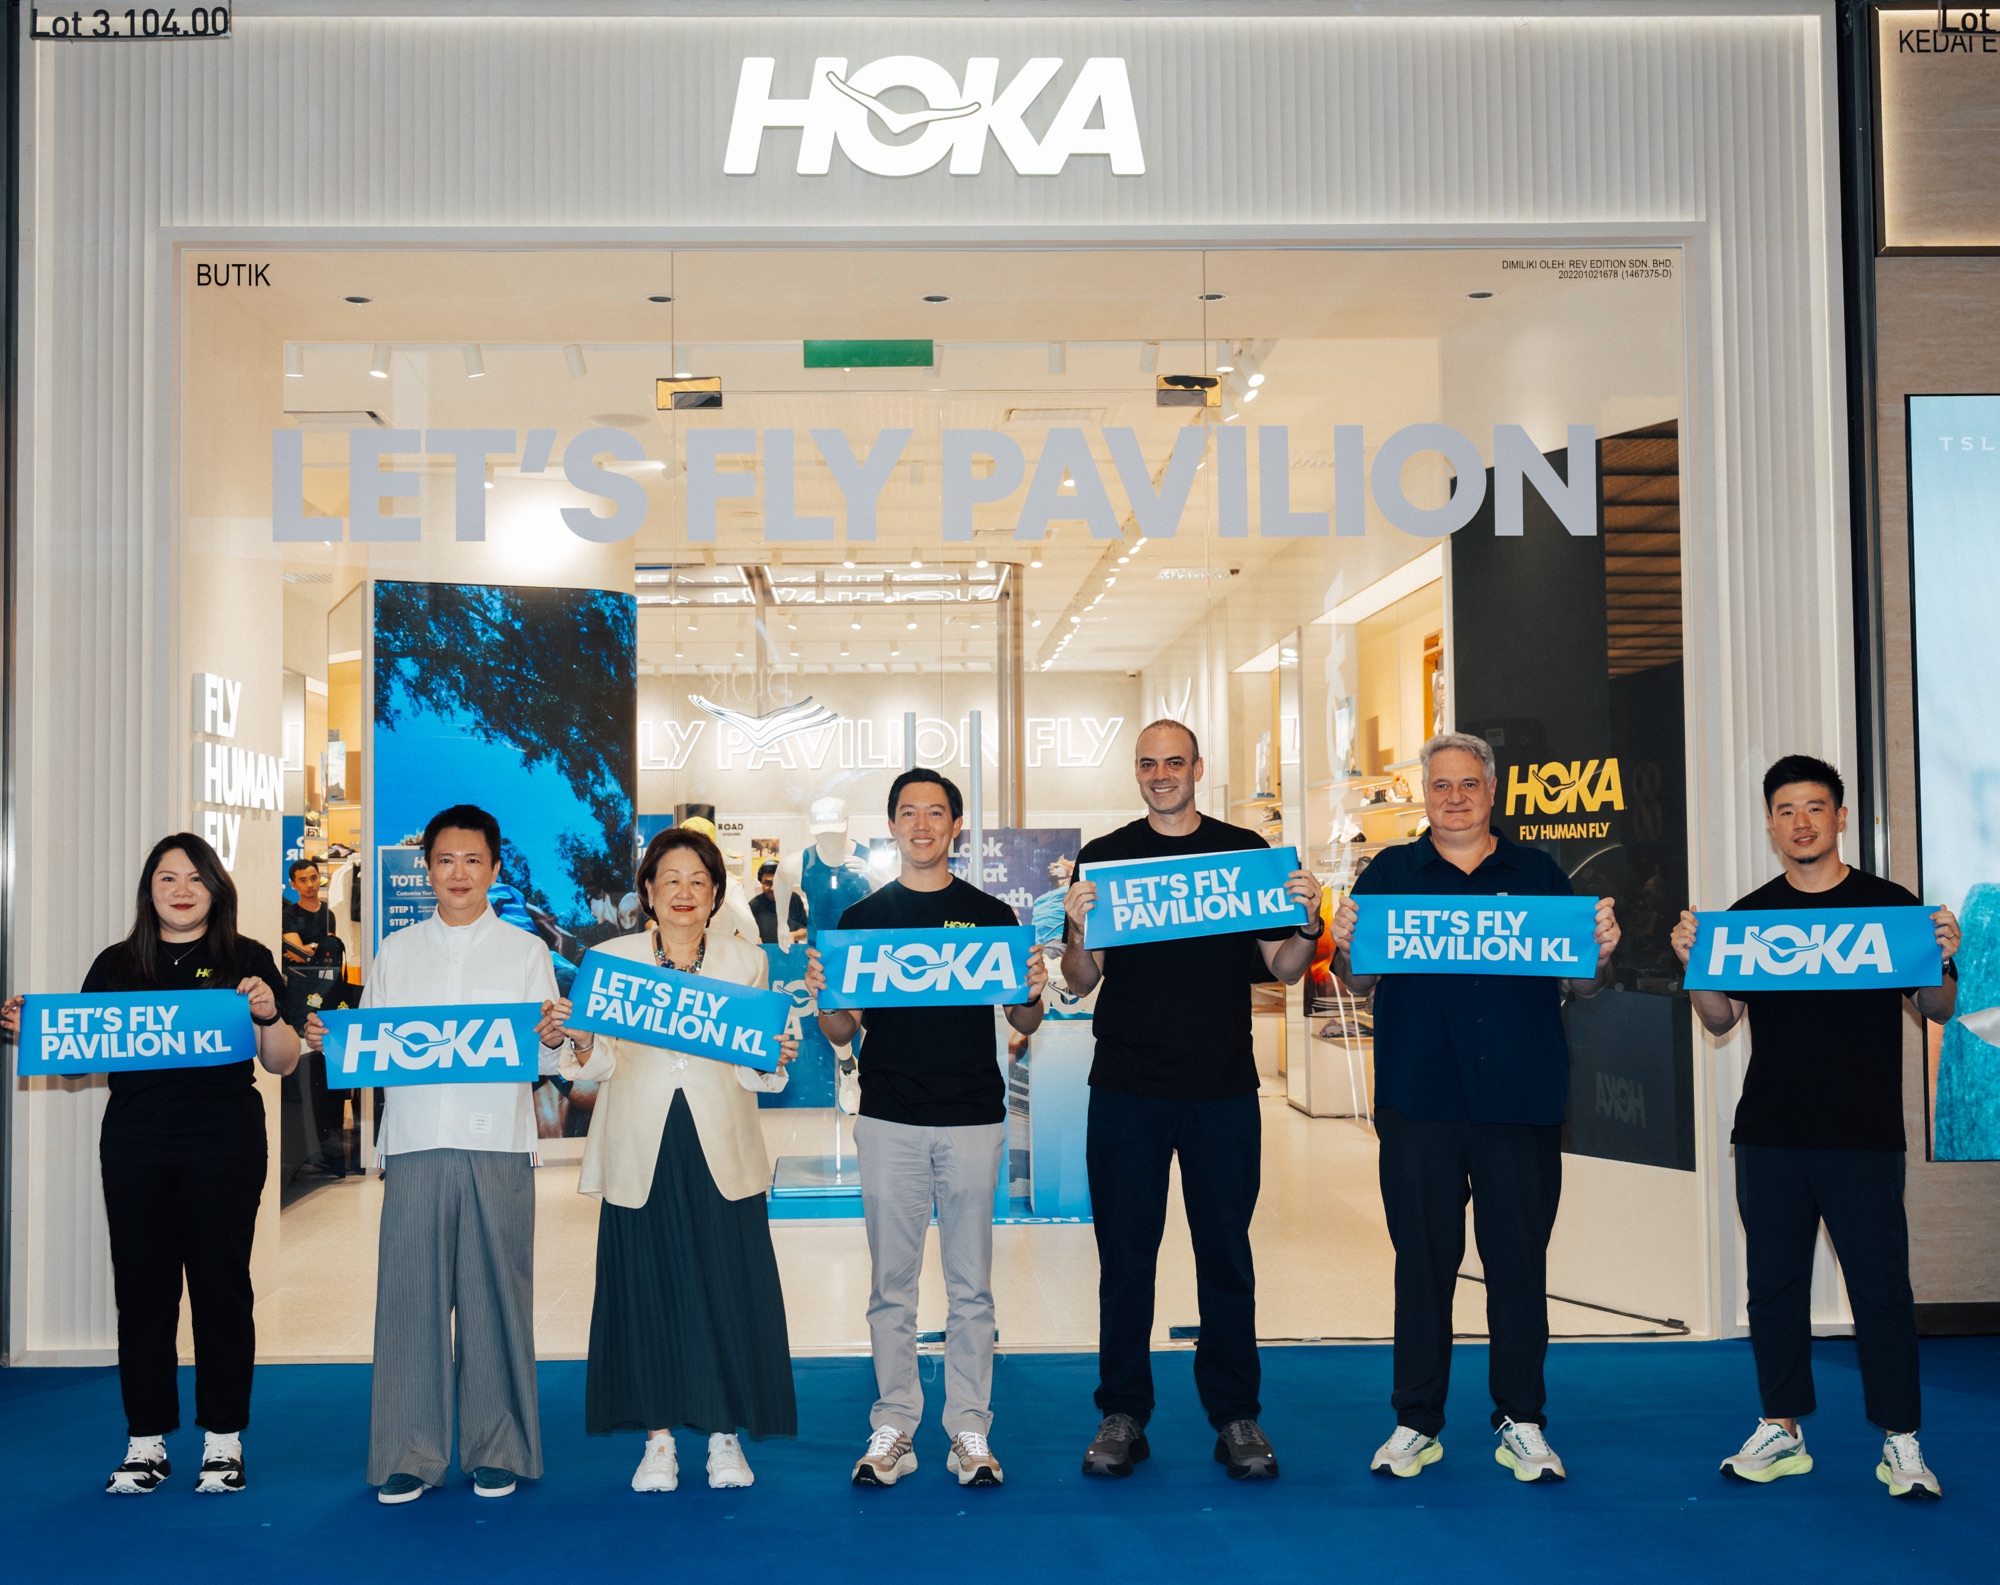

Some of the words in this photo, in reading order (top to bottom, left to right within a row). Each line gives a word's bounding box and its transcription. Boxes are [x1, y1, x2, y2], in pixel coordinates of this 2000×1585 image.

[31, 8, 83, 37] Lot
[92, 7, 229, 37] 3.104.00
[1941, 4, 1997, 33] Lot
[723, 55, 1146, 177] HOKA
[196, 263, 271, 287] BUTIK
[1502, 260, 1537, 269] DIMILIKI
[1539, 260, 1567, 269] OLEH:
[1569, 259, 1587, 268] REV
[1590, 259, 1626, 268] EDITION
[1628, 259, 1650, 268] SDN.
[1652, 259, 1674, 268] BHD.
[1558, 269, 1619, 279] 202201021678
[1621, 269, 1672, 280] (1467375-D)
[271, 427, 649, 543] LET'S
[685, 428, 914, 542] FLY
[940, 422, 1598, 541] PAVILION
[203, 672, 242, 738] FLY
[637, 719, 705, 770] LY
[716, 717, 1000, 771] PAVILION
[1026, 717, 1125, 768] FLY
[203, 741, 284, 812] HUMAN
[1505, 757, 1625, 816] HOKA
[203, 811, 242, 872] FLY
[1519, 825, 1539, 841] FLY
[1540, 823, 1587, 840] HUMAN
[1588, 821, 1611, 838] FLY
[390, 875, 423, 887] TOTE
[1109, 873, 1189, 906] LET'S
[1193, 866, 1241, 896] FLY
[389, 905, 409, 914] STEP
[389, 918, 409, 926] STEP
[410, 918, 415, 926] 2
[1112, 891, 1252, 931] PAVILION
[1257, 887, 1295, 914] KL
[1387, 909, 1470, 935] LET'S
[1476, 910, 1528, 936] FLY
[841, 941, 1018, 993] HOKA
[1387, 935, 1532, 962] PAVILION
[1540, 937, 1579, 962] KL
[1707, 923, 1893, 976] HOKA
[591, 967, 673, 1008] LET'S
[676, 987, 730, 1020] FLY
[41, 1006, 123, 1034] LET'S
[129, 1005, 180, 1032] FLY
[586, 993, 728, 1047] PAVILION
[731, 1025, 767, 1057] KL
[41, 1031, 186, 1061] PAVILION
[193, 1029, 232, 1054] KL
[342, 1018, 520, 1074] HOKA
